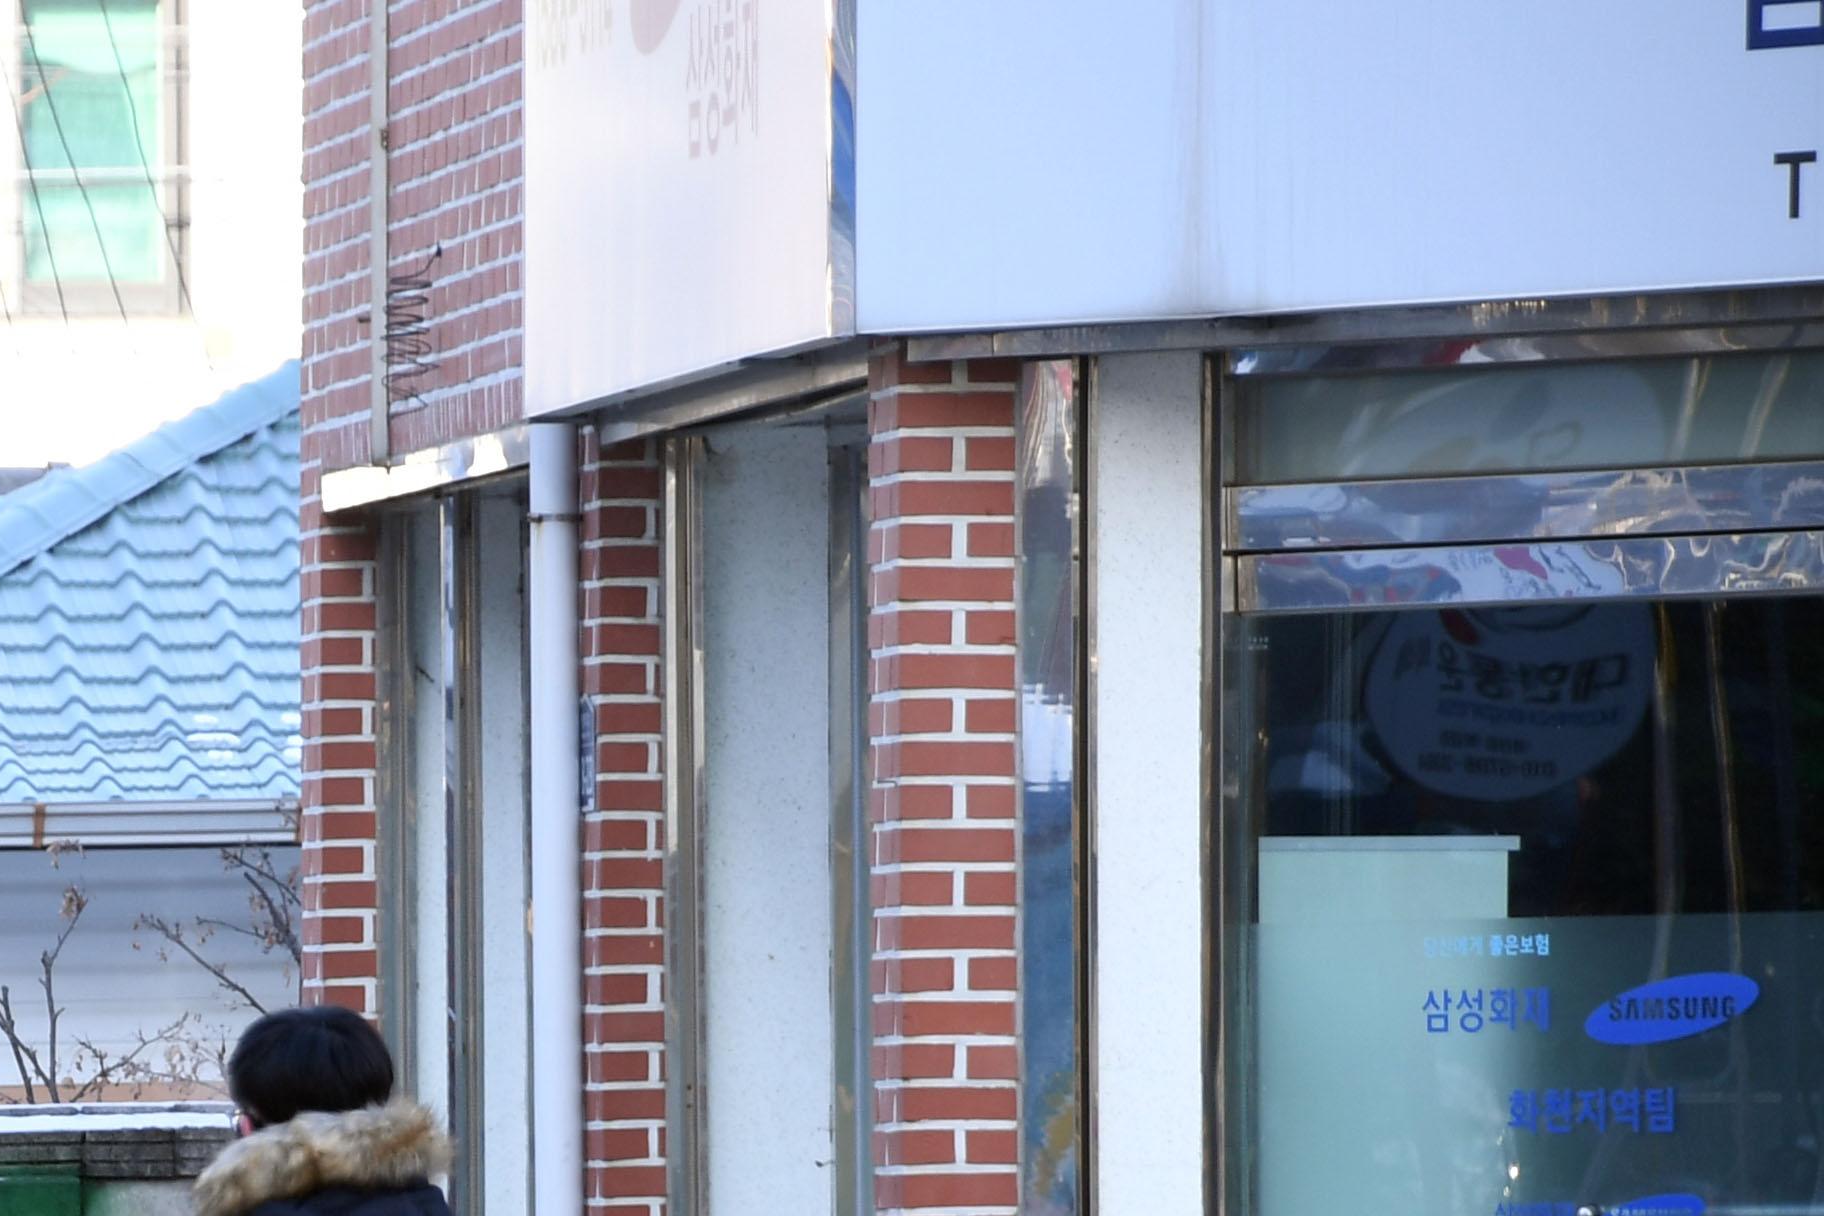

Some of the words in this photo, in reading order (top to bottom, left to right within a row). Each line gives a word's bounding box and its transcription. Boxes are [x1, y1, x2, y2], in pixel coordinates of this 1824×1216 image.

[686, 0, 758, 159] 삼성화재
[1489, 933, 1550, 956] 좋은보험
[1422, 987, 1552, 1033] 삼성화재
[1609, 995, 1736, 1022] SAMSUNG
[1507, 1087, 1675, 1133] 화천지역팀
